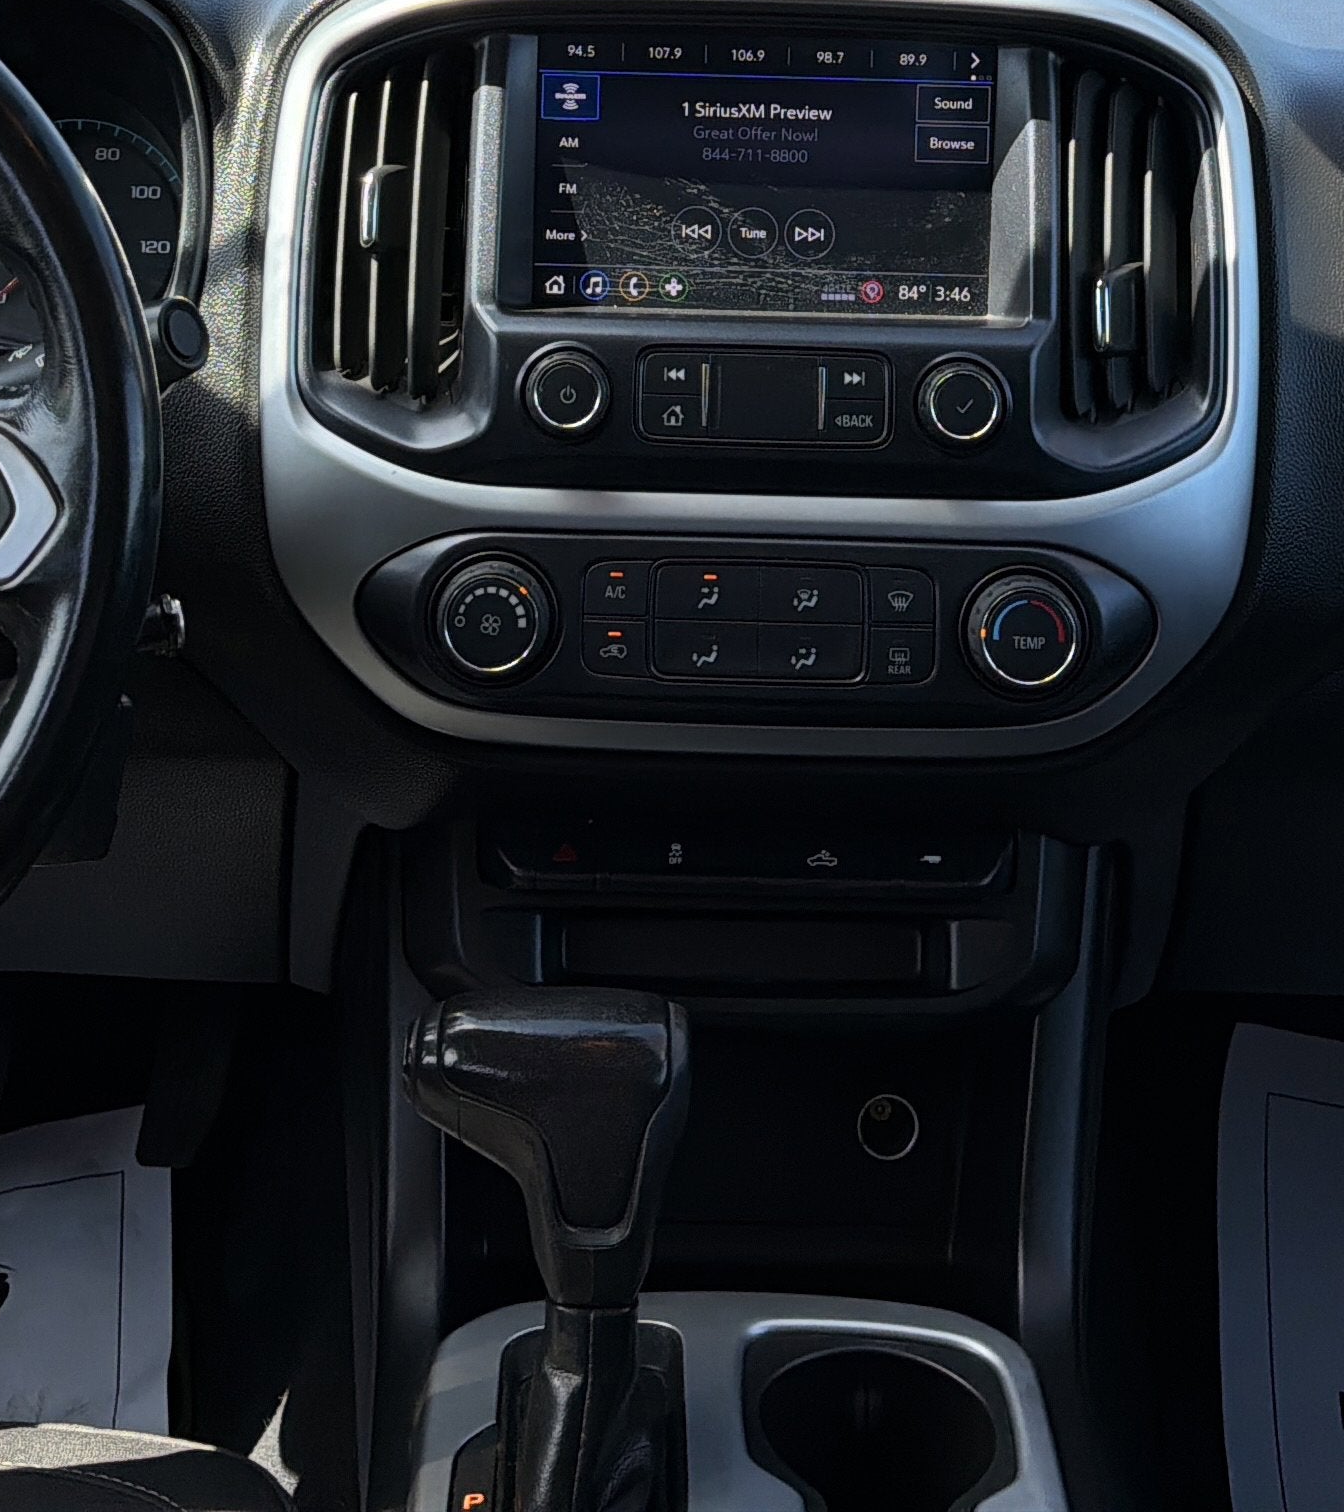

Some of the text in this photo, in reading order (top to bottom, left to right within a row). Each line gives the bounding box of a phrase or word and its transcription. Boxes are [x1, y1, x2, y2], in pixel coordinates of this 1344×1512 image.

[567, 44, 596, 58] 94.5
[648, 46, 683, 61] 107.9
[731, 48, 766, 62] 106.9
[816, 50, 845, 65] 98.7
[899, 52, 928, 67] 89.9
[934, 96, 974, 111] Sound
[680, 102, 833, 123] 1 SiriusXM Preview
[692, 125, 820, 143] Great Offer Now!
[559, 136, 580, 149] AM
[929, 136, 975, 150] Browse
[94, 147, 121, 161] 80
[702, 146, 809, 163] 844-711-8800
[131, 186, 161, 199] 100
[558, 183, 578, 195] FM
[545, 229, 577, 242] More
[739, 226, 768, 240] Tune
[139, 240, 171, 254] 120
[898, 284, 972, 303] 84° 3:46
[842, 413, 874, 429] BACK
[604, 584, 627, 601] A/C
[1012, 635, 1046, 652] TEMP
[887, 664, 912, 676] REAR
[668, 856, 683, 865] OFF
[463, 1492, 484, 1510] P
